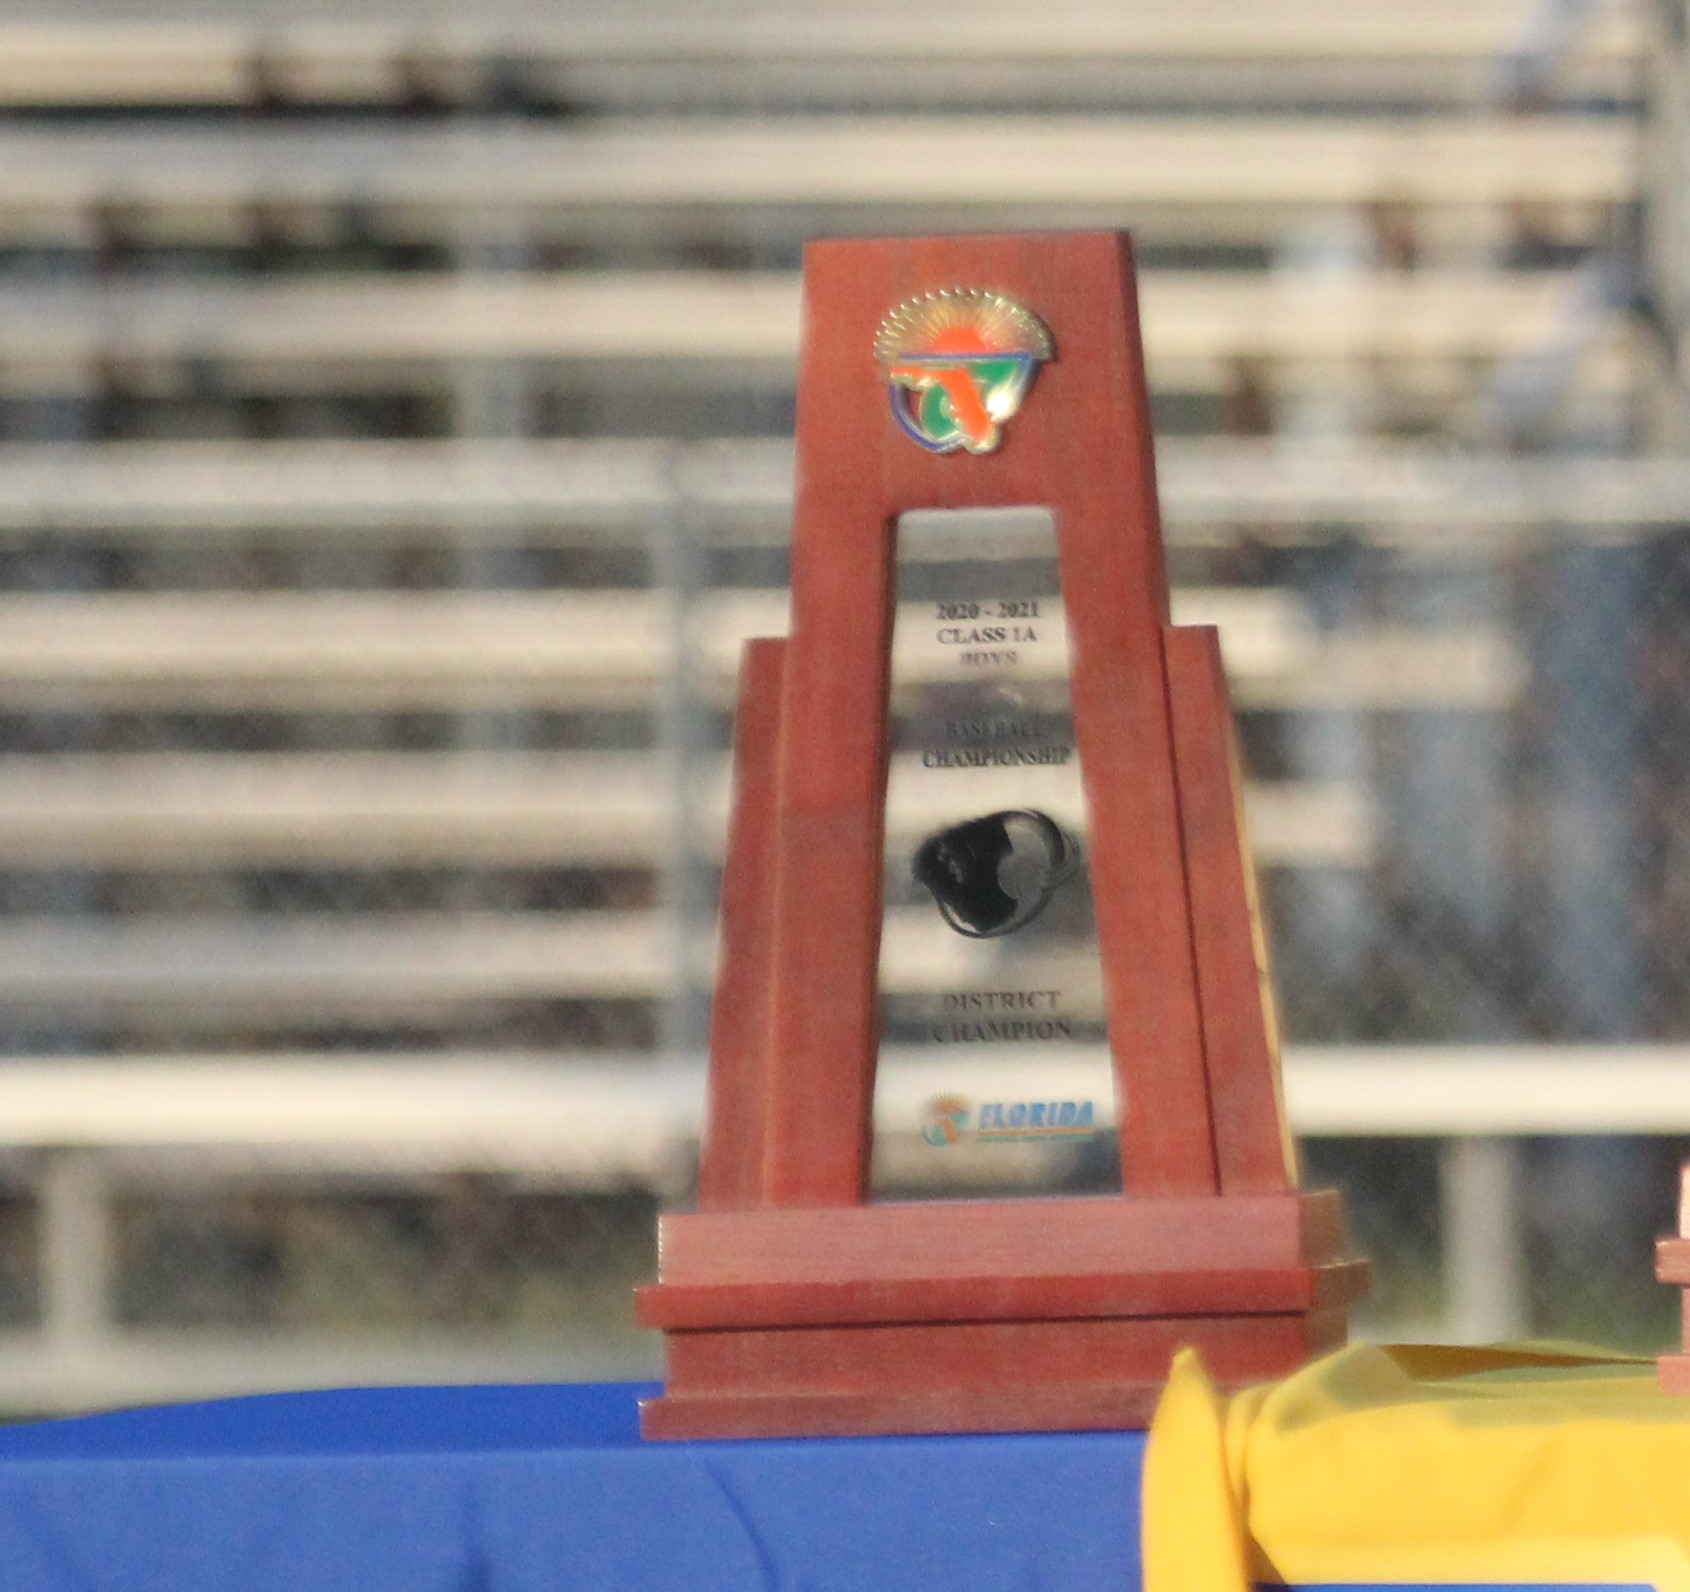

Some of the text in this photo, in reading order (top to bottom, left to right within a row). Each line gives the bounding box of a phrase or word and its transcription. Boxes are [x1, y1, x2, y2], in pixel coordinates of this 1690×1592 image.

[998, 601, 1040, 619] 2021
[936, 626, 1038, 644] CLASS 1A
[922, 746, 1072, 768] CHAMPIONSHIP
[943, 990, 1061, 1010] DISTRICT
[932, 1019, 1073, 1044] CHAMPION
[977, 1101, 1095, 1130] FLORIDA
